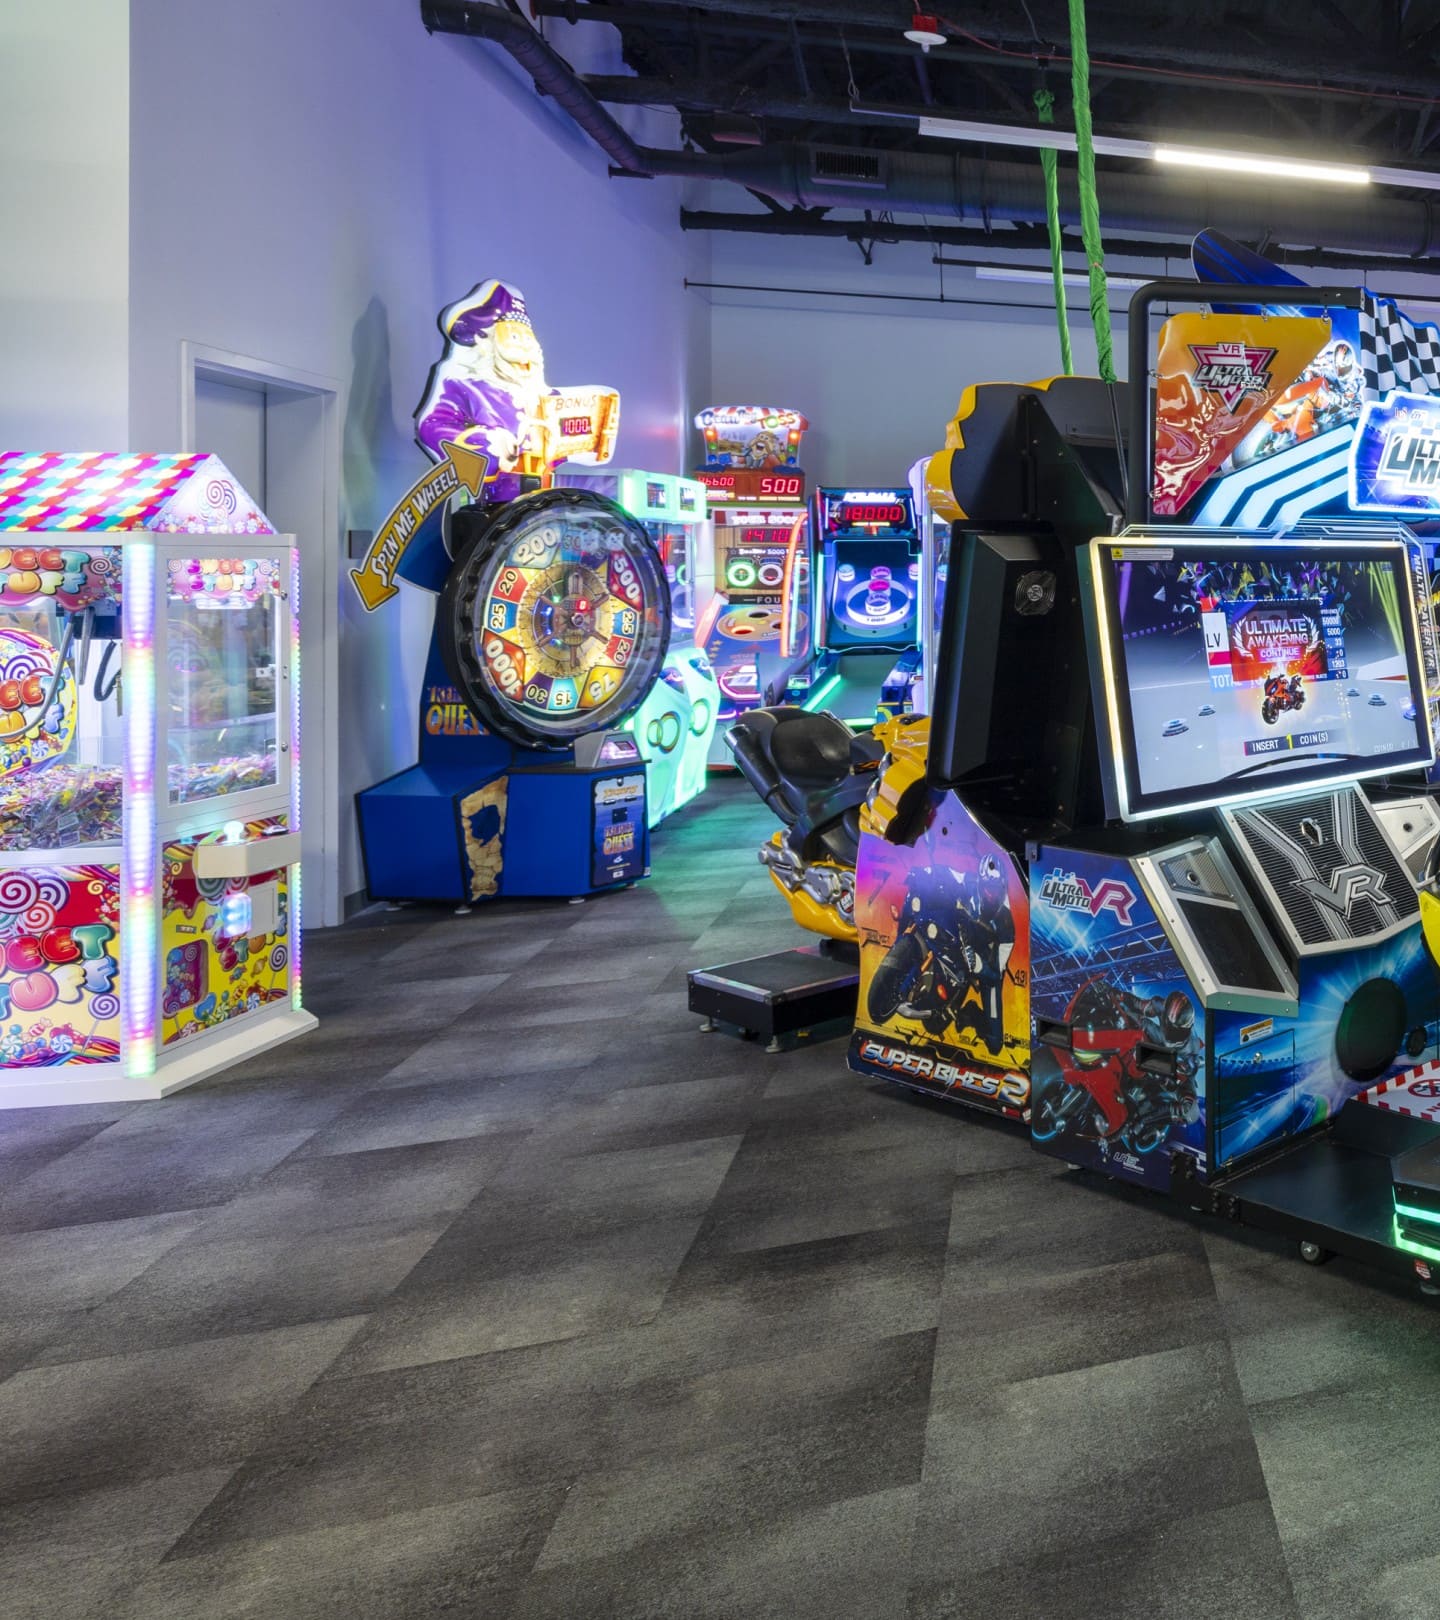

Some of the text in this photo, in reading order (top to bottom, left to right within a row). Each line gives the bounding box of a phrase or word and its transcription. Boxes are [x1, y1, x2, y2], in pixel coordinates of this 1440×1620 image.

[1222, 344, 1240, 354] VR
[1197, 365, 1254, 380] ULTRA
[555, 394, 596, 412] BONUS
[564, 419, 589, 434] 1000
[761, 478, 800, 494] 500
[845, 505, 901, 521] 18000
[370, 462, 459, 587] SPIN ME WHEEL!
[517, 527, 558, 564] 200
[500, 570, 517, 595] 20
[613, 557, 641, 600] 500
[491, 604, 507, 629] 25
[622, 610, 634, 635] 25
[1245, 618, 1307, 635] ULTIMATE
[1206, 632, 1221, 648] LV
[1246, 632, 1309, 649] AWAKENING
[614, 640, 629, 664] 20
[1260, 646, 1300, 658] CONTINUE
[485, 639, 524, 696] 1000
[526, 684, 549, 704] 30
[589, 673, 616, 701] 75
[555, 690, 572, 706] 15
[1252, 731, 1329, 753] INSERT 1 COIN(S)
[1042, 880, 1083, 898] ULTRA
[1290, 863, 1397, 918] VR
[1052, 892, 1091, 908] MOTO
[1075, 879, 1134, 921] VR
[863, 1042, 1031, 1106] SUPER BIKES 2
